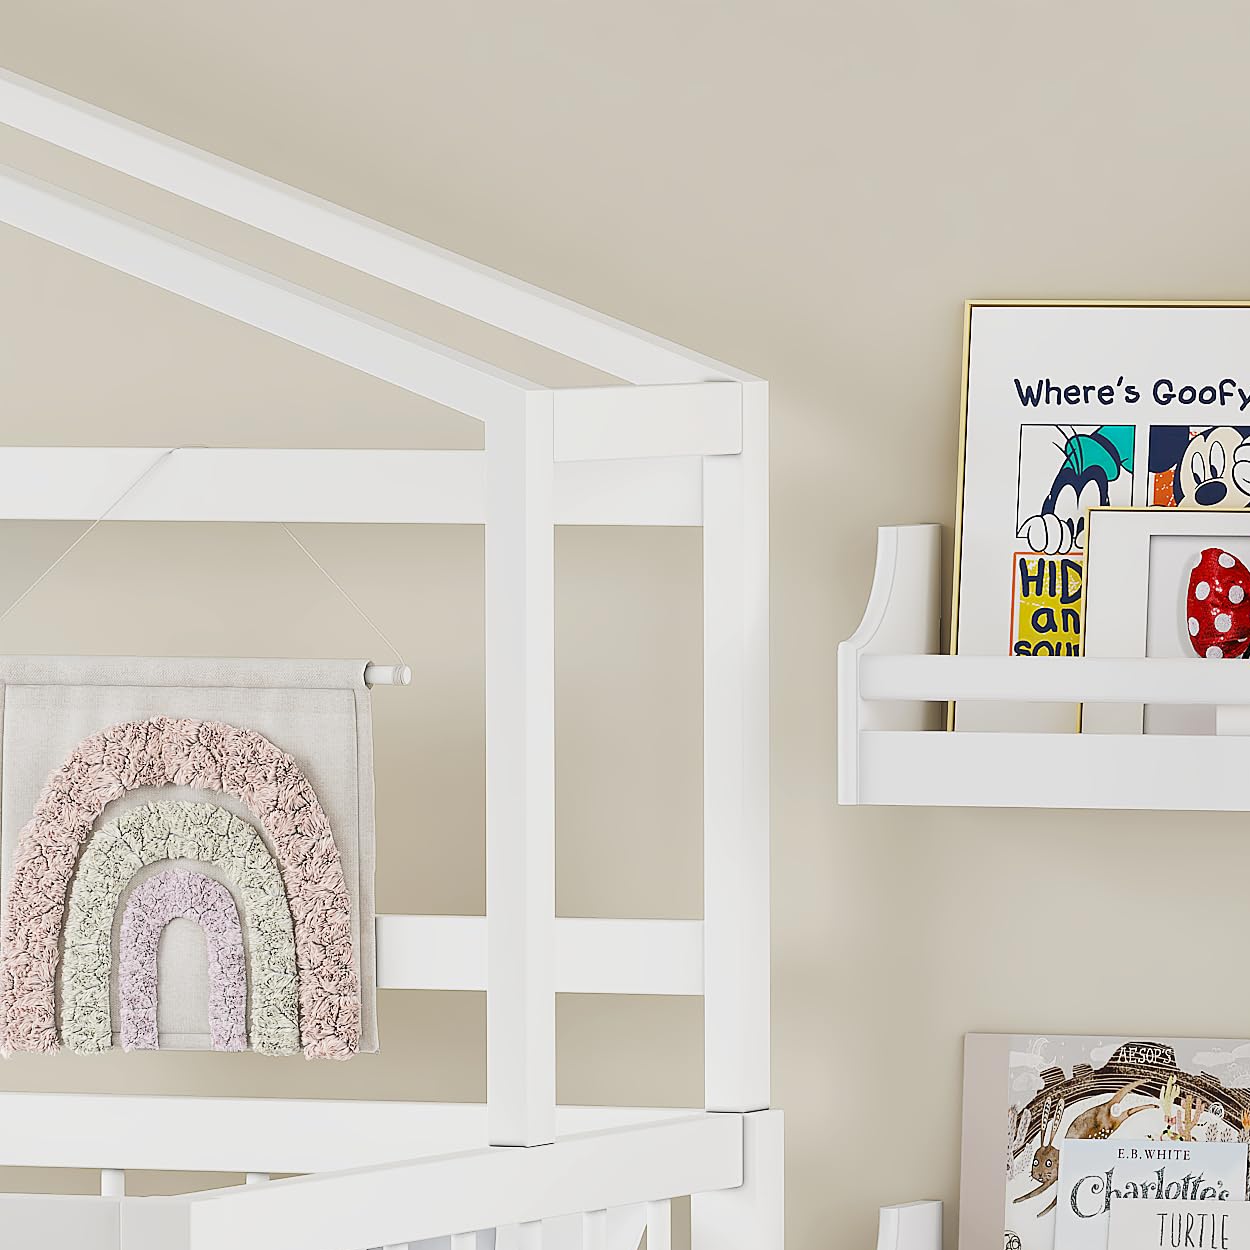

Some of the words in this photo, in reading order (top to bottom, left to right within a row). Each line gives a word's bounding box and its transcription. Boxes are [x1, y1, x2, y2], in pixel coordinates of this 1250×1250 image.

[1013, 376, 1141, 407] Where's
[1119, 1047, 1172, 1064] AESOP'S
[1156, 1212, 1229, 1250] TURTLE
